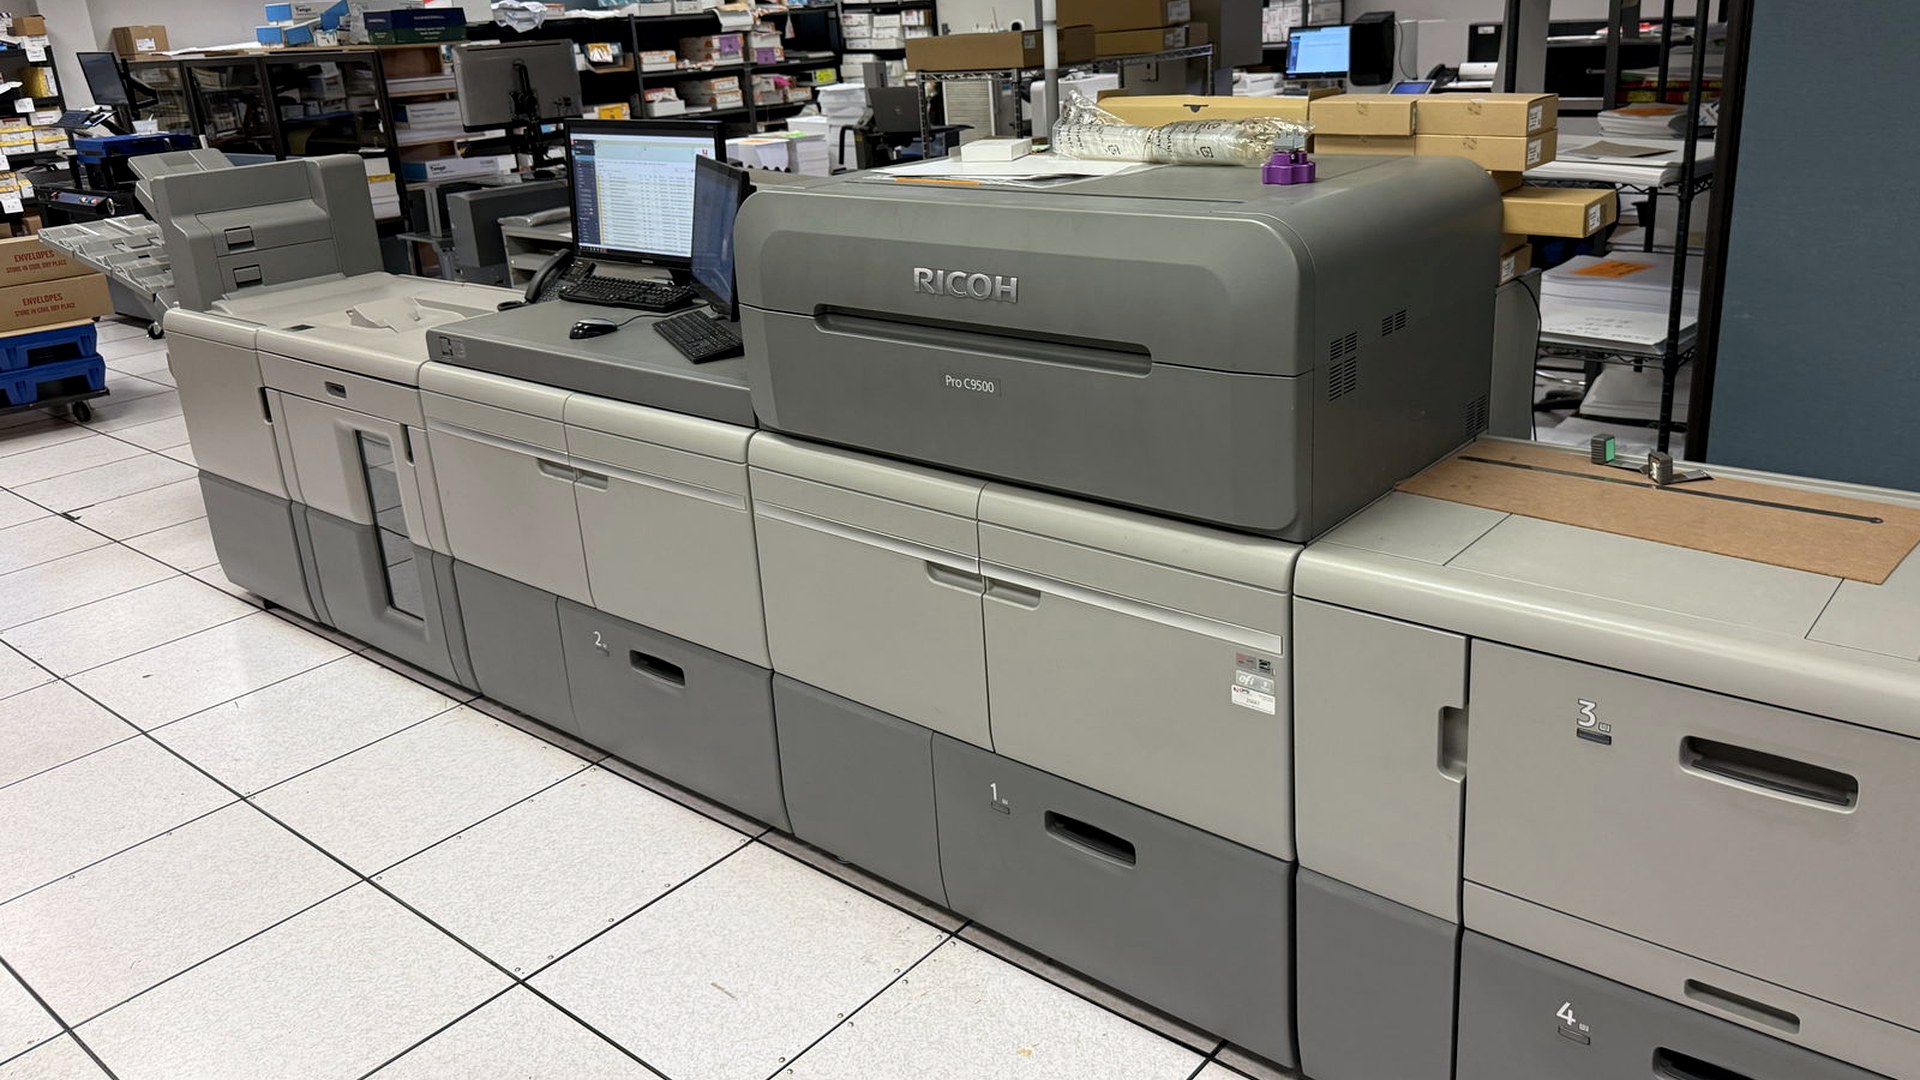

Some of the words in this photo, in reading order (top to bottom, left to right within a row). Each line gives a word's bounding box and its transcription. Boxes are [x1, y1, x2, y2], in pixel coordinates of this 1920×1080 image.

[14, 250, 55, 262] ENVELOPES
[913, 267, 1018, 303] RICOH
[22, 293, 63, 306] ENVELOPES
[945, 374, 962, 388] Pro
[963, 378, 994, 393] C9500
[593, 631, 602, 647] 2
[1577, 699, 1597, 728] 3
[990, 783, 997, 801] 1
[1556, 1001, 1577, 1026] 4
